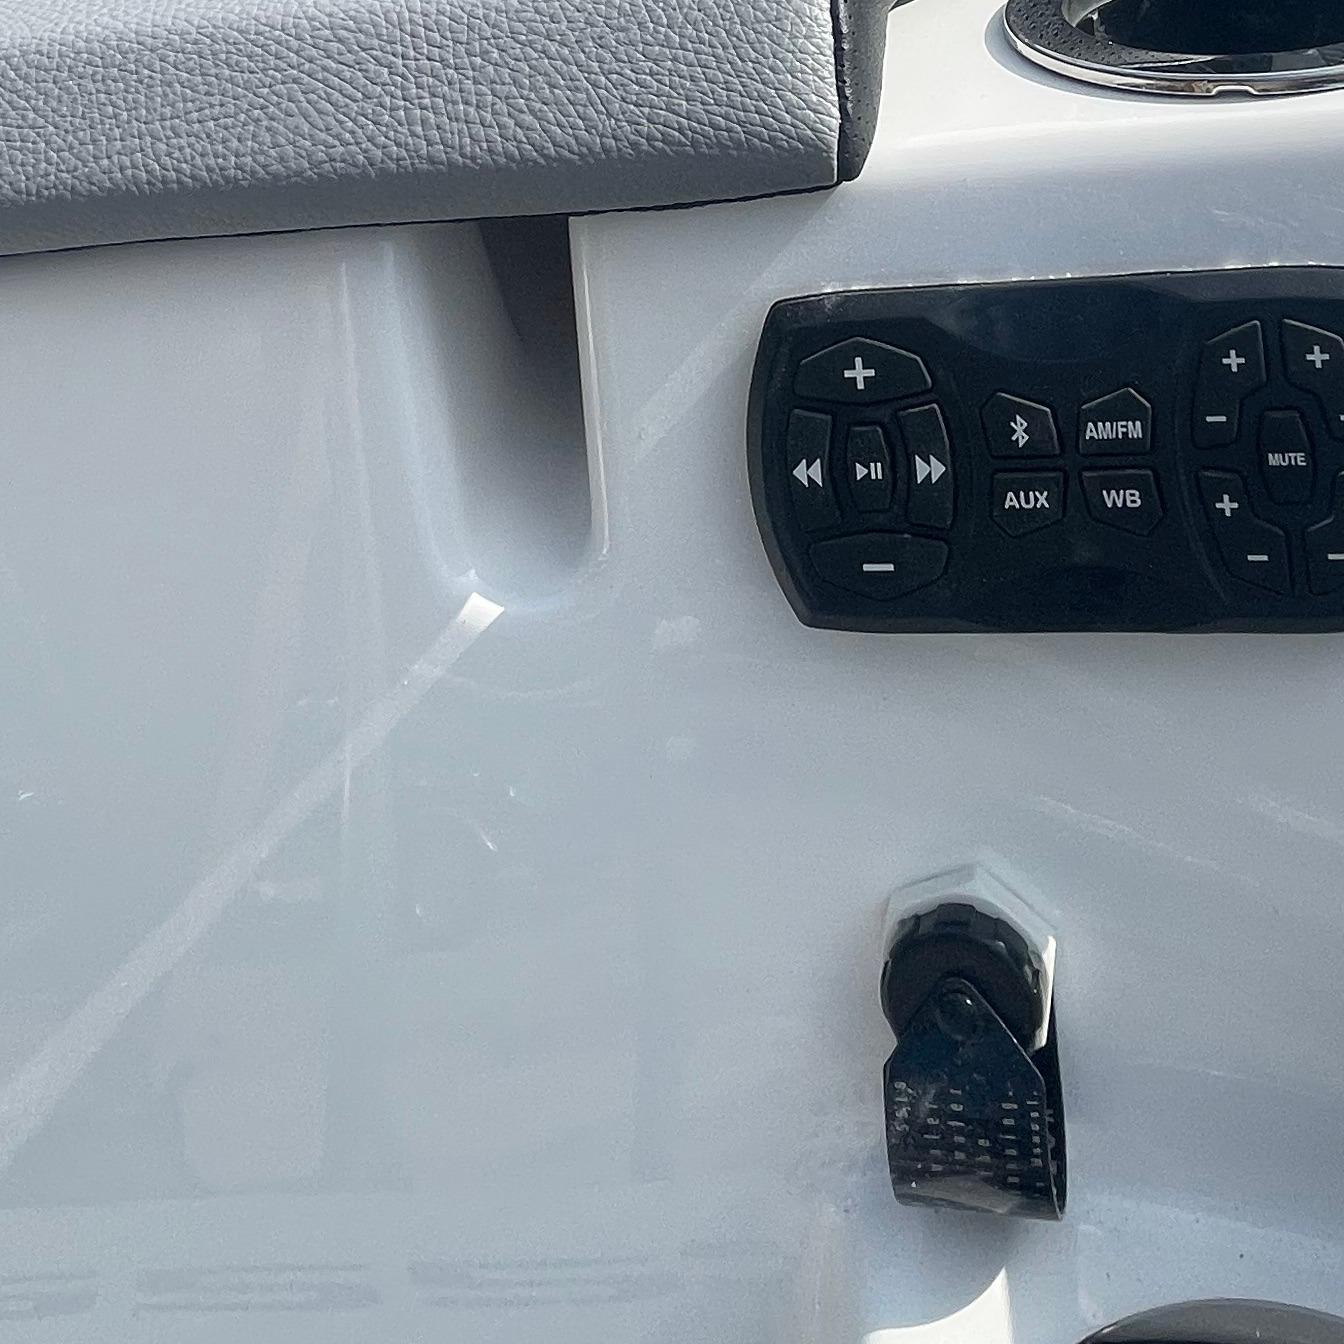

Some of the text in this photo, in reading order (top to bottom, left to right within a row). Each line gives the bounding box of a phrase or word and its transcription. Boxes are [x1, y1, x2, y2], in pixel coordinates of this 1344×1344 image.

[1084, 421, 1142, 441] AM/FM
[1267, 452, 1307, 466] MUTE
[1003, 489, 1050, 509] AUX
[1102, 488, 1142, 508] WB
